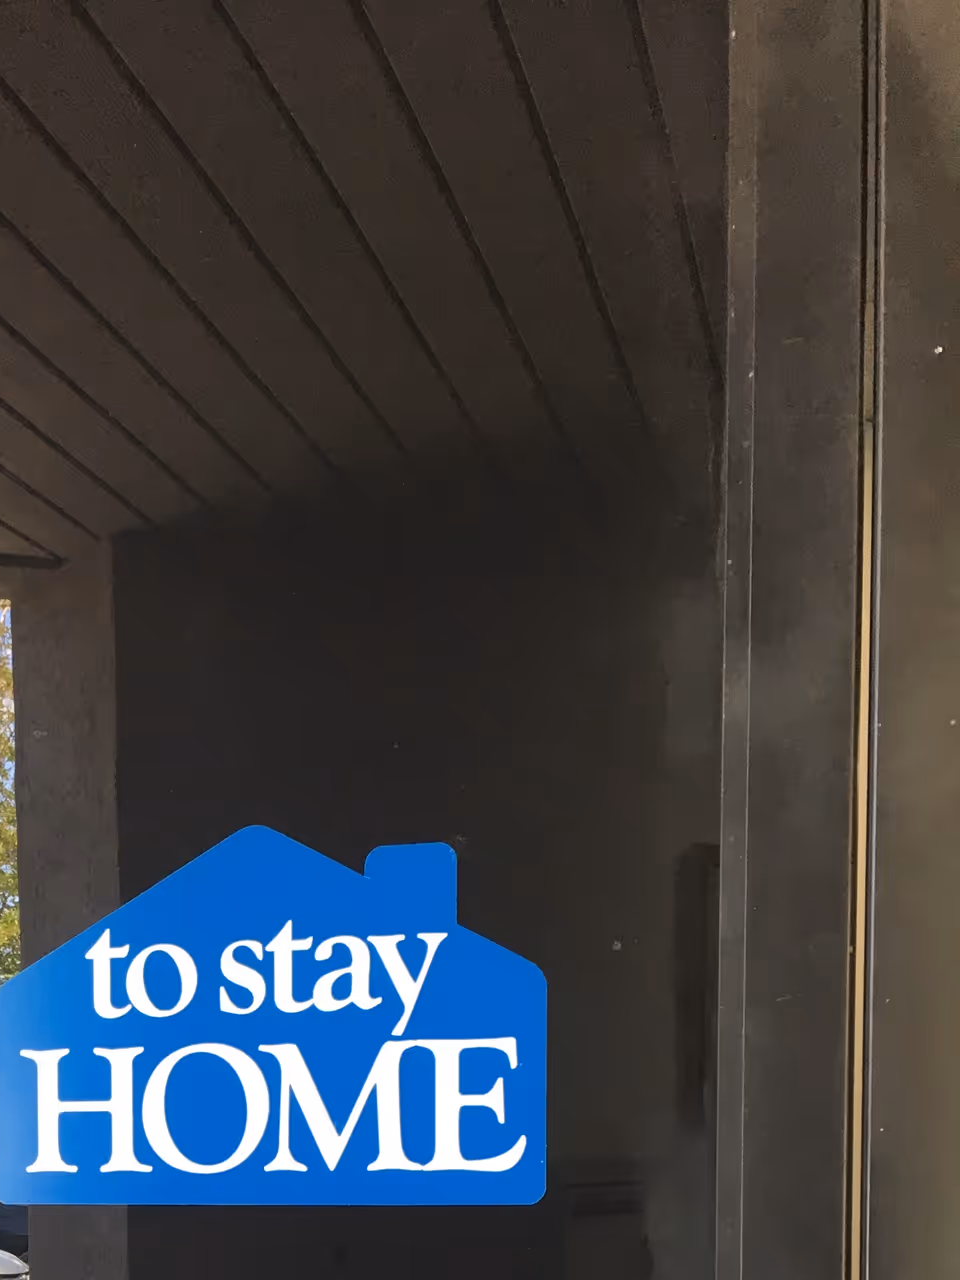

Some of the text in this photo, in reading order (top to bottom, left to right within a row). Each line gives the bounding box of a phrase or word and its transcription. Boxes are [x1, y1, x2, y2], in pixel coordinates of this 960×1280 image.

[85, 919, 449, 1036] to stay
[20, 1036, 527, 1175] HOME
